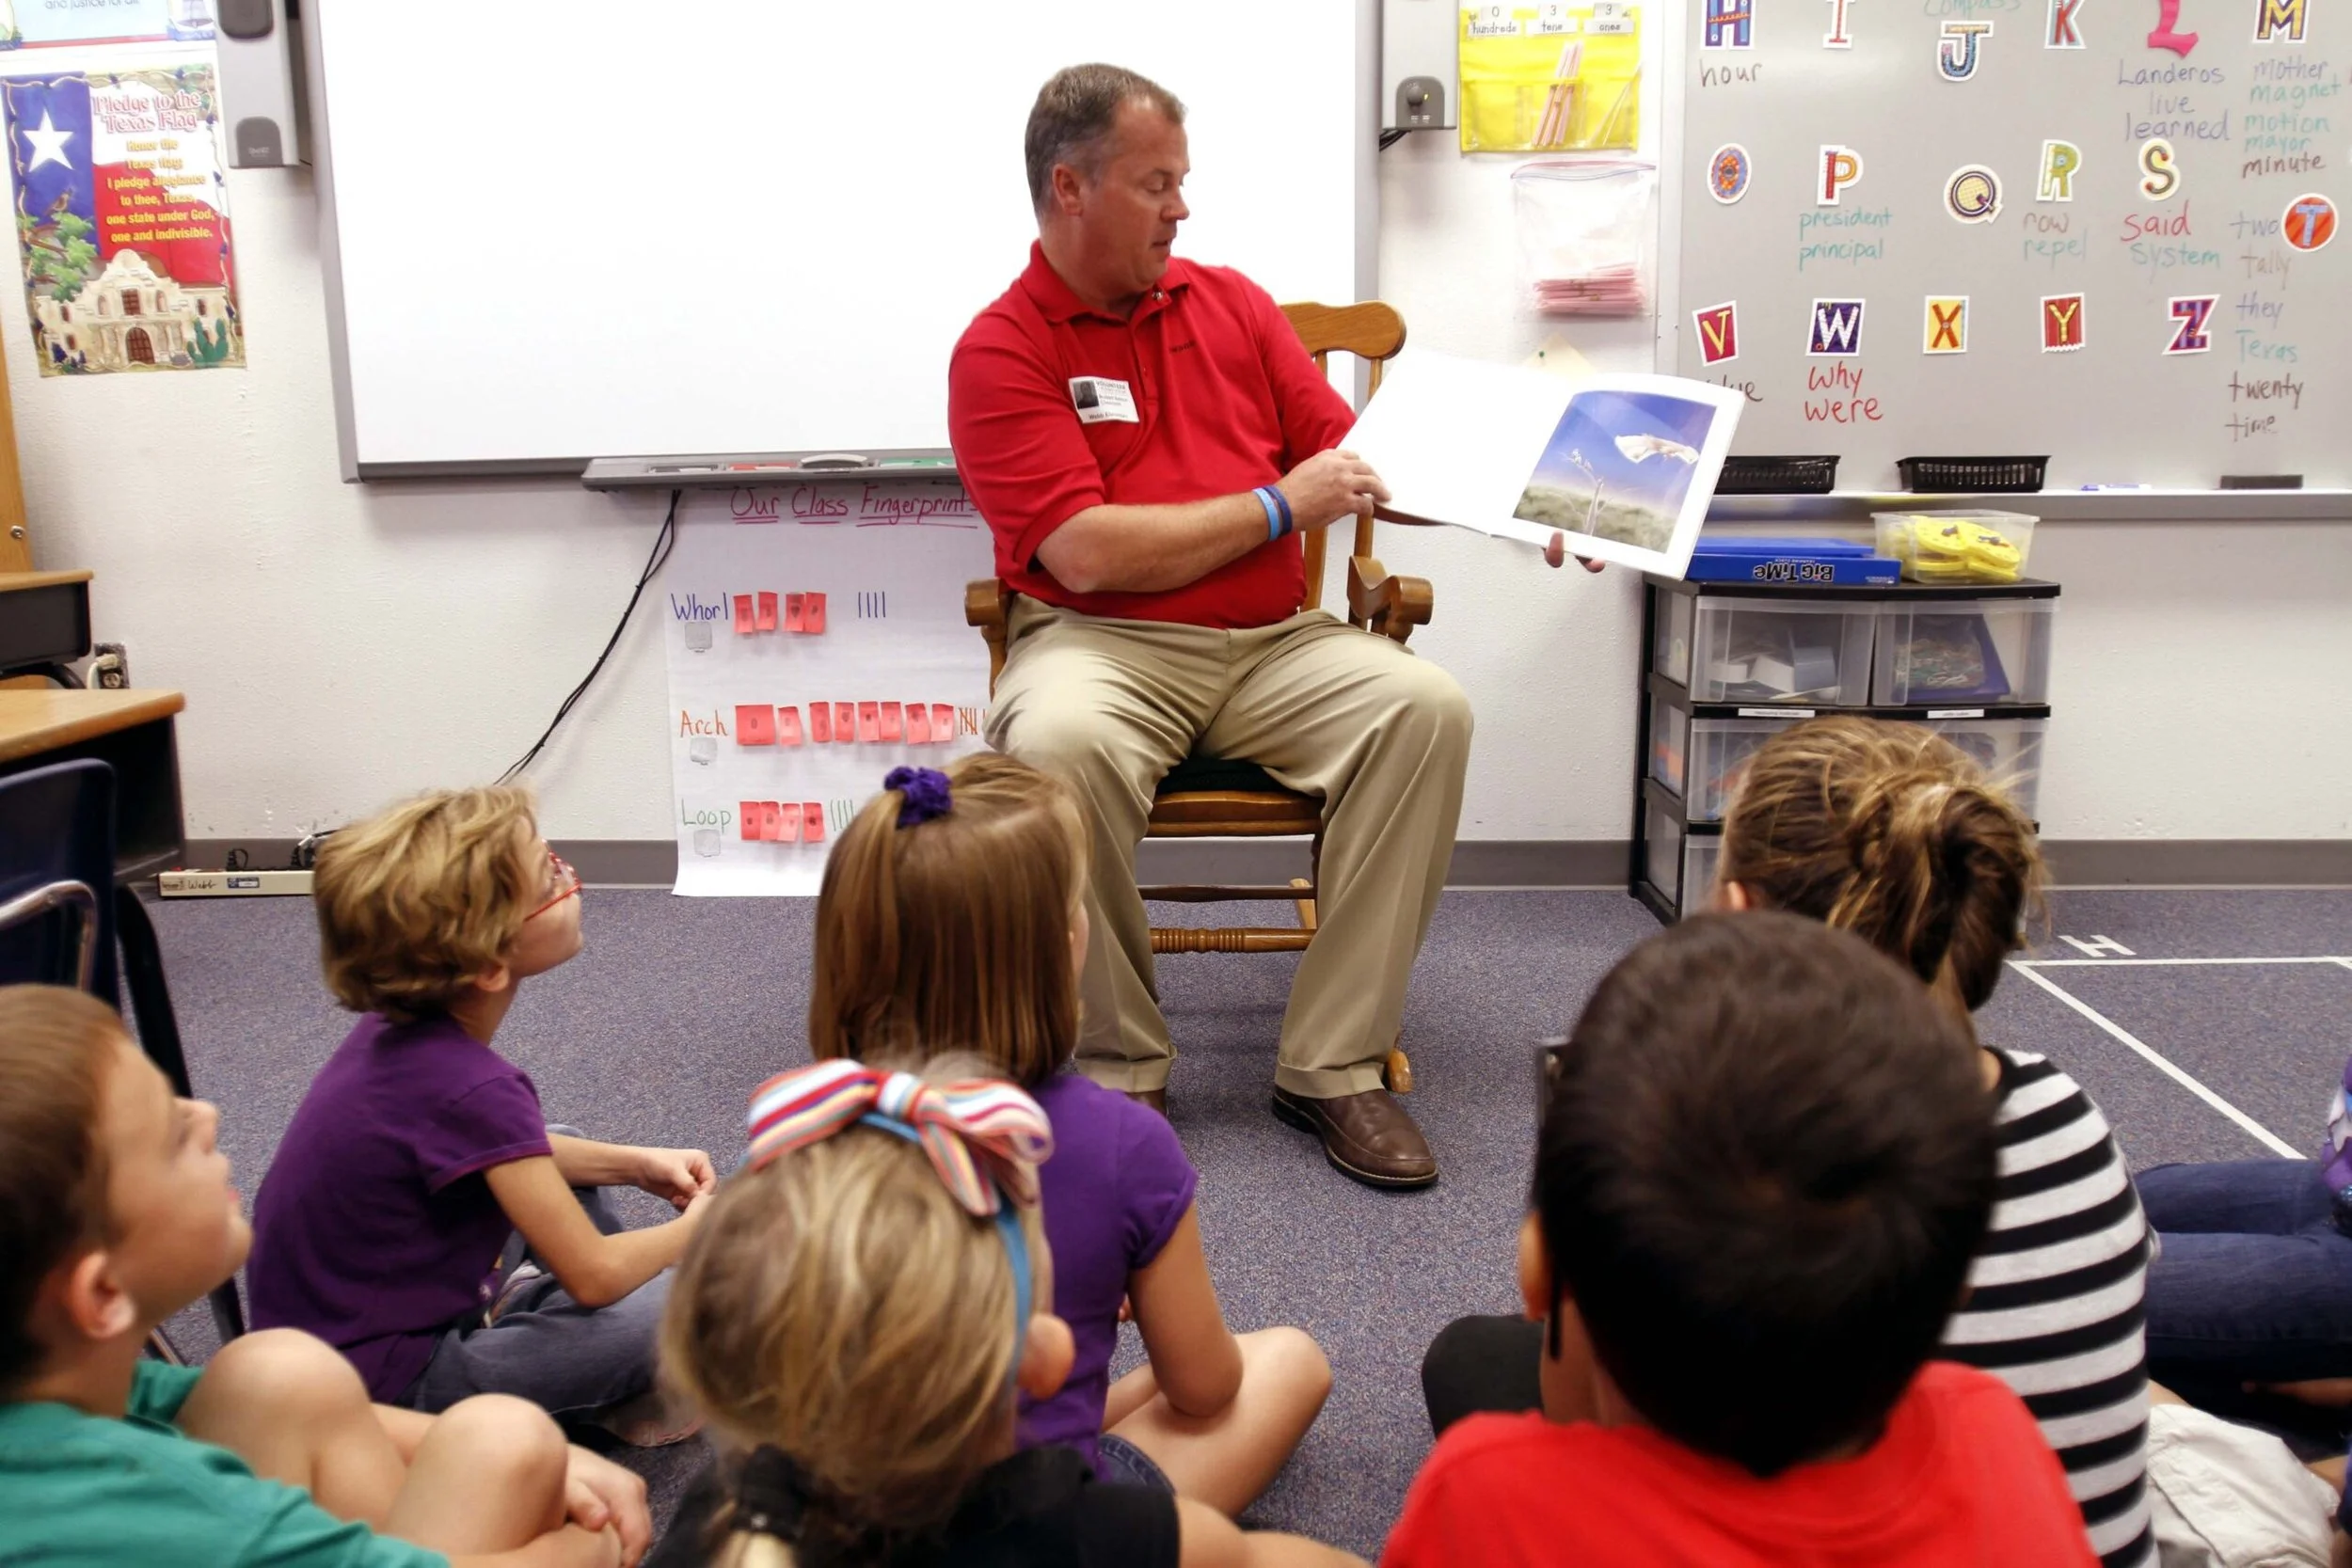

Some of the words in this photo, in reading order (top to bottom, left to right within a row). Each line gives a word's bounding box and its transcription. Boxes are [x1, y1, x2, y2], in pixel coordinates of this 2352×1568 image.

[1549, 5, 1557, 16] 3
[1605, 4, 1613, 16] 3
[1705, 0, 1751, 46] H
[2046, 0, 2085, 47] K
[2257, 0, 2307, 40] M
[1472, 22, 1517, 34] hundreds
[2148, 0, 2199, 57] L
[1941, 24, 1990, 77] J
[1699, 58, 1762, 87] hour
[2119, 58, 2226, 85] Landeros
[2253, 55, 2328, 81] mother
[93, 95, 149, 114] Pledge
[153, 94, 173, 110] to
[175, 91, 201, 109] the
[2150, 90, 2195, 114] live
[2249, 72, 2342, 109] magnet
[103, 112, 155, 134] Texas
[158, 109, 198, 133] Flag
[2125, 109, 2231, 141] learned
[2245, 112, 2330, 133] motion
[127, 141, 157, 151] Honor
[160, 138, 178, 150] the
[2245, 135, 2312, 154] mayor
[127, 159, 155, 170] Texas
[1824, 150, 1857, 199] P
[2041, 143, 2079, 198] R
[2144, 144, 2174, 196] S
[2242, 151, 2327, 179] minute
[114, 177, 151, 192] pledge
[152, 174, 205, 188] allegiance
[1949, 170, 1997, 217] Q
[120, 196, 131, 206] to
[134, 195, 161, 208] thee,
[163, 192, 198, 205] Texas,
[106, 215, 126, 226] one
[128, 213, 155, 224] state
[158, 211, 188, 222] under
[191, 209, 215, 223] God,
[1800, 206, 1893, 241] president
[2229, 210, 2280, 239] two
[2296, 204, 2328, 246] T
[111, 232, 131, 243] one
[133, 230, 153, 241] and
[155, 227, 213, 239] indivisible.
[2024, 229, 2087, 270] repel
[1800, 238, 1883, 272] principal
[2047, 301, 2078, 344] Y
[2168, 297, 2217, 351] Z
[2235, 290, 2284, 329] they
[1701, 309, 1732, 356] V
[1818, 304, 1860, 352] W
[1931, 301, 1963, 349] X
[2228, 371, 2304, 410] twenty
[1805, 397, 1883, 423] were
[2224, 412, 2279, 442] time
[730, 486, 780, 515] Our
[791, 486, 849, 515] Class
[671, 592, 729, 620] Whorl
[680, 709, 729, 737] Arch
[681, 799, 732, 833] Loop
